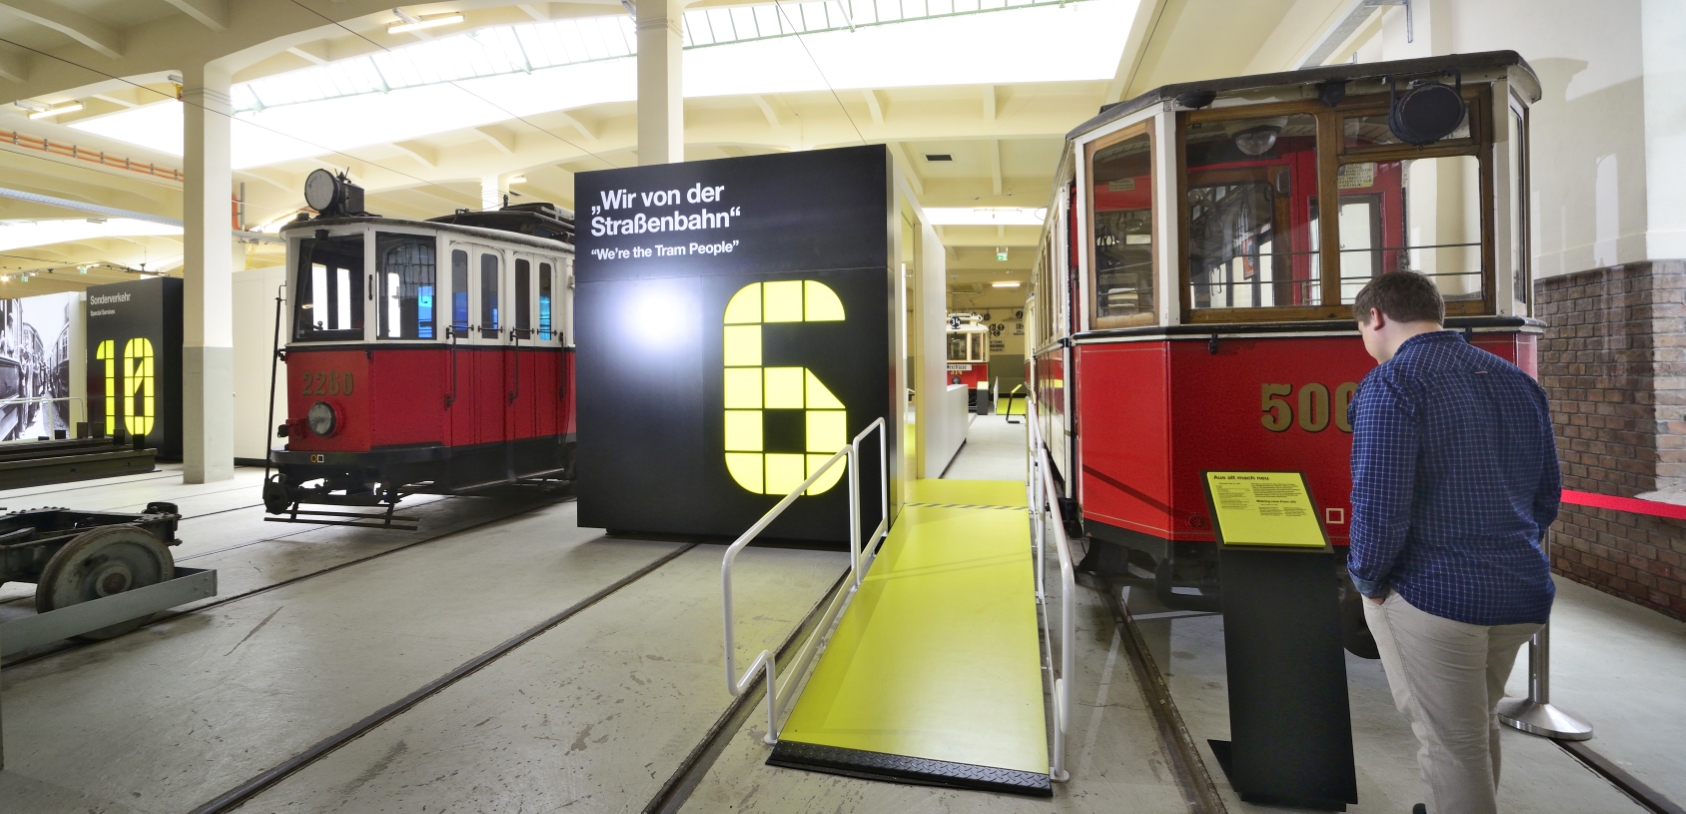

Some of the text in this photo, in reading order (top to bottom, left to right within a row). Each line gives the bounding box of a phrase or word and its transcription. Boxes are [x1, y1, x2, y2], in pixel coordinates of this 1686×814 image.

[591, 182, 725, 216] „Wir von der
[591, 206, 741, 237] Straßenbahn“
[633, 245, 652, 259] the
[655, 243, 686, 257] Tram
[689, 240, 739, 256] People”
[90, 292, 131, 305] Sonderverkehr
[96, 337, 154, 436] 10
[302, 370, 354, 396] 2260
[723, 280, 847, 496] 6
